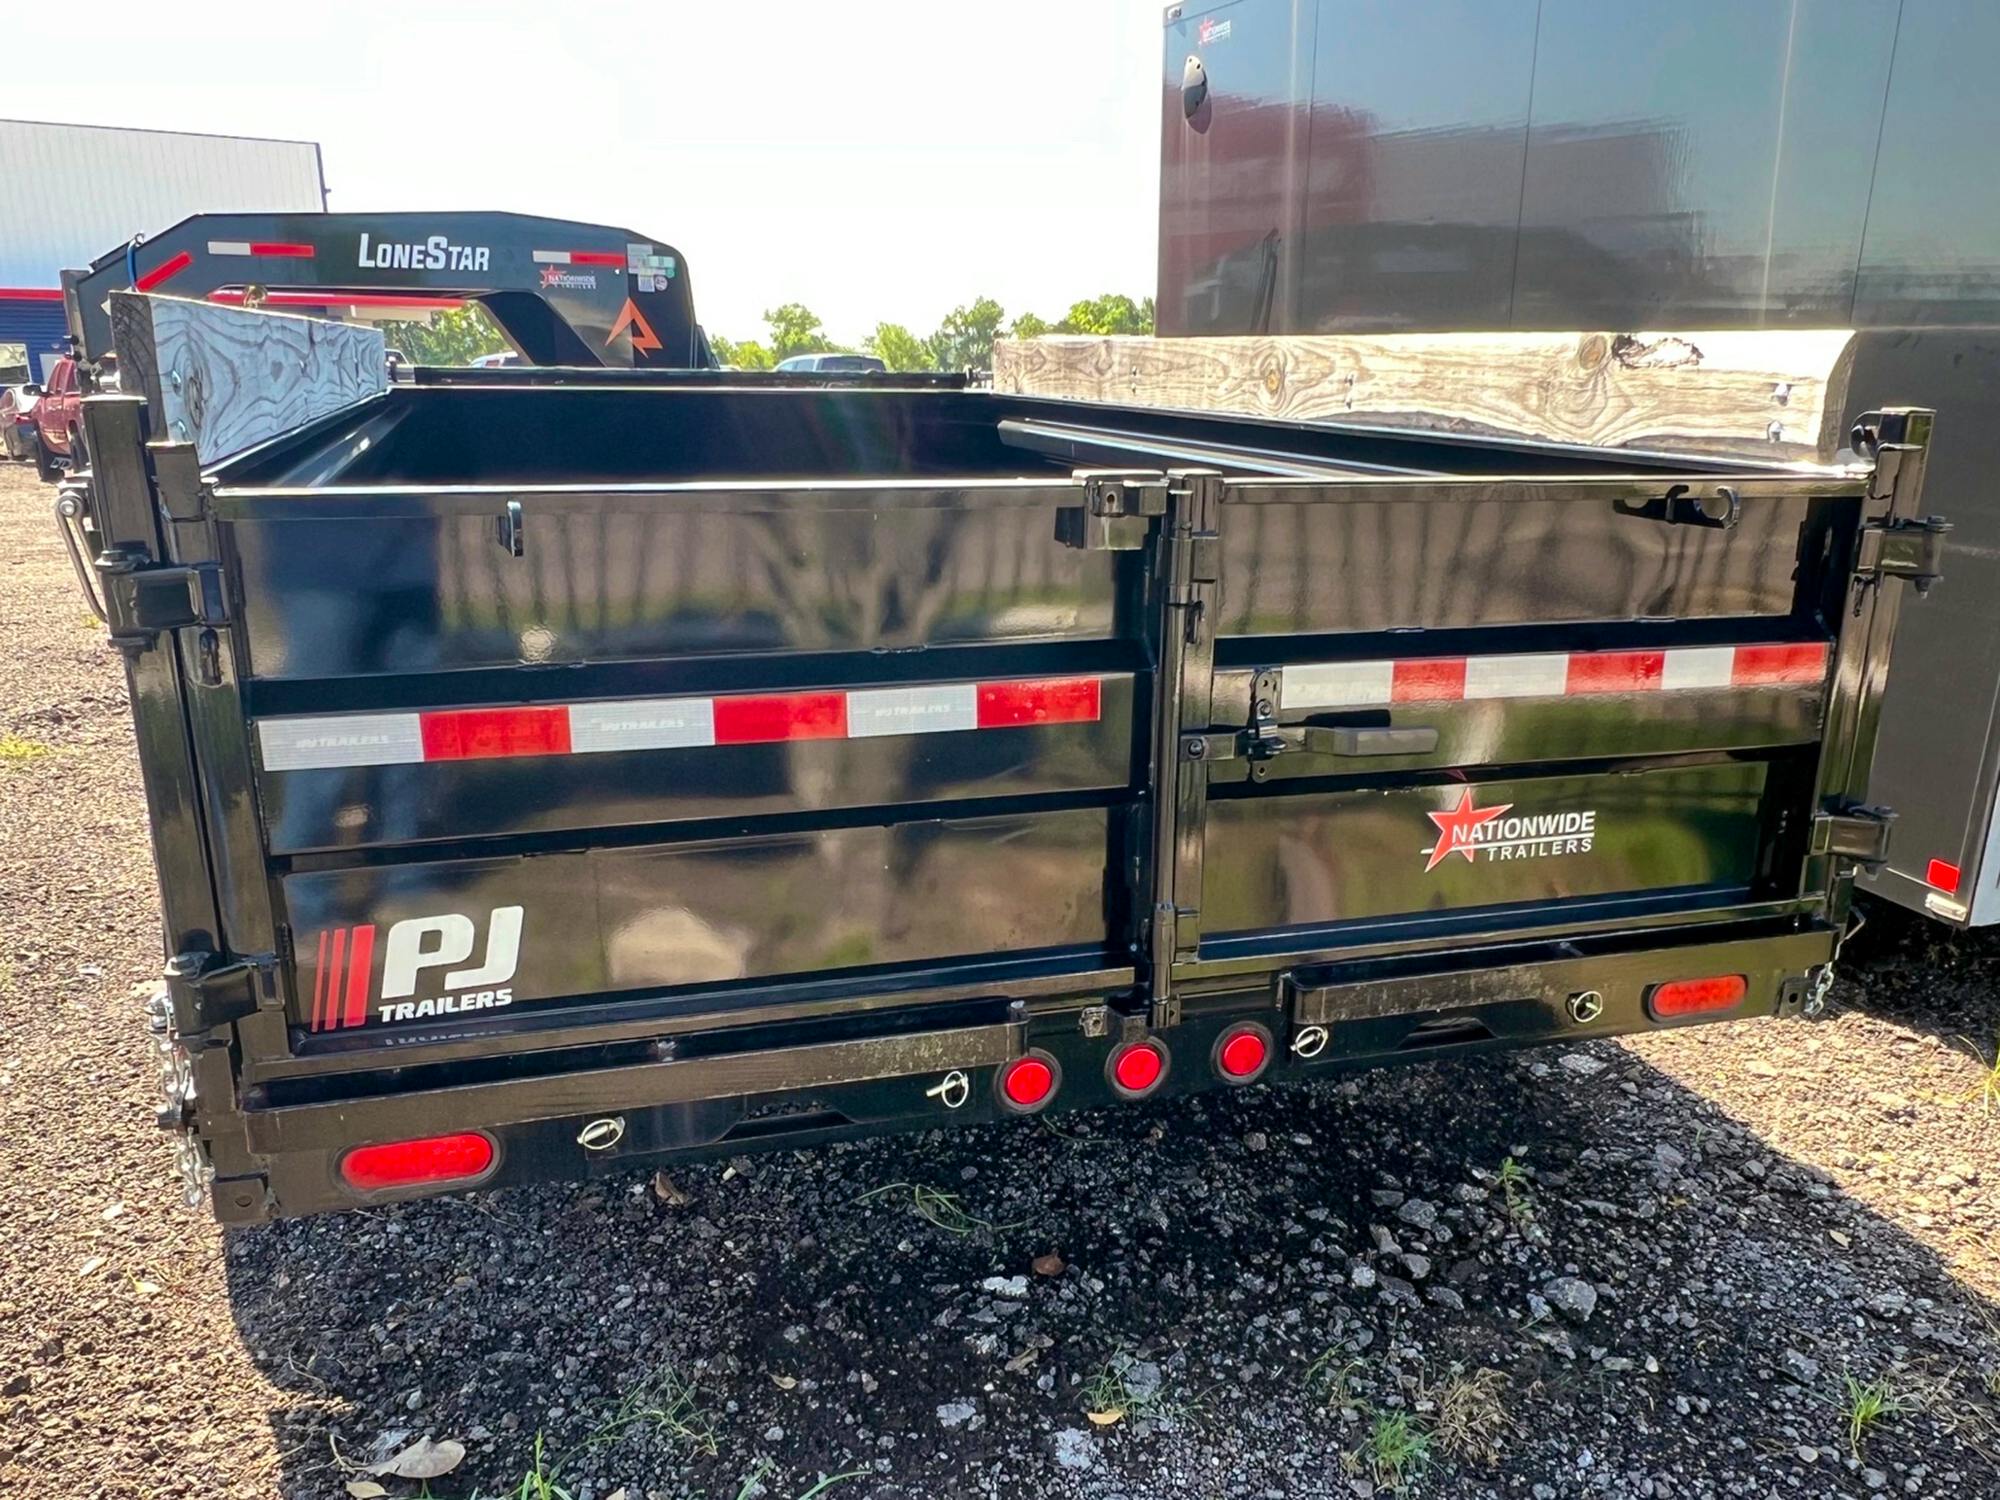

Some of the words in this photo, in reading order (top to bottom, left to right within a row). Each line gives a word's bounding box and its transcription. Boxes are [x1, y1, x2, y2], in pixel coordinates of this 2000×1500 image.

[1451, 811, 1596, 843] NATIONWIDE
[1487, 838, 1592, 862] TRAILERS
[381, 905, 524, 999] PJ
[378, 988, 513, 1023] TRAILERS
